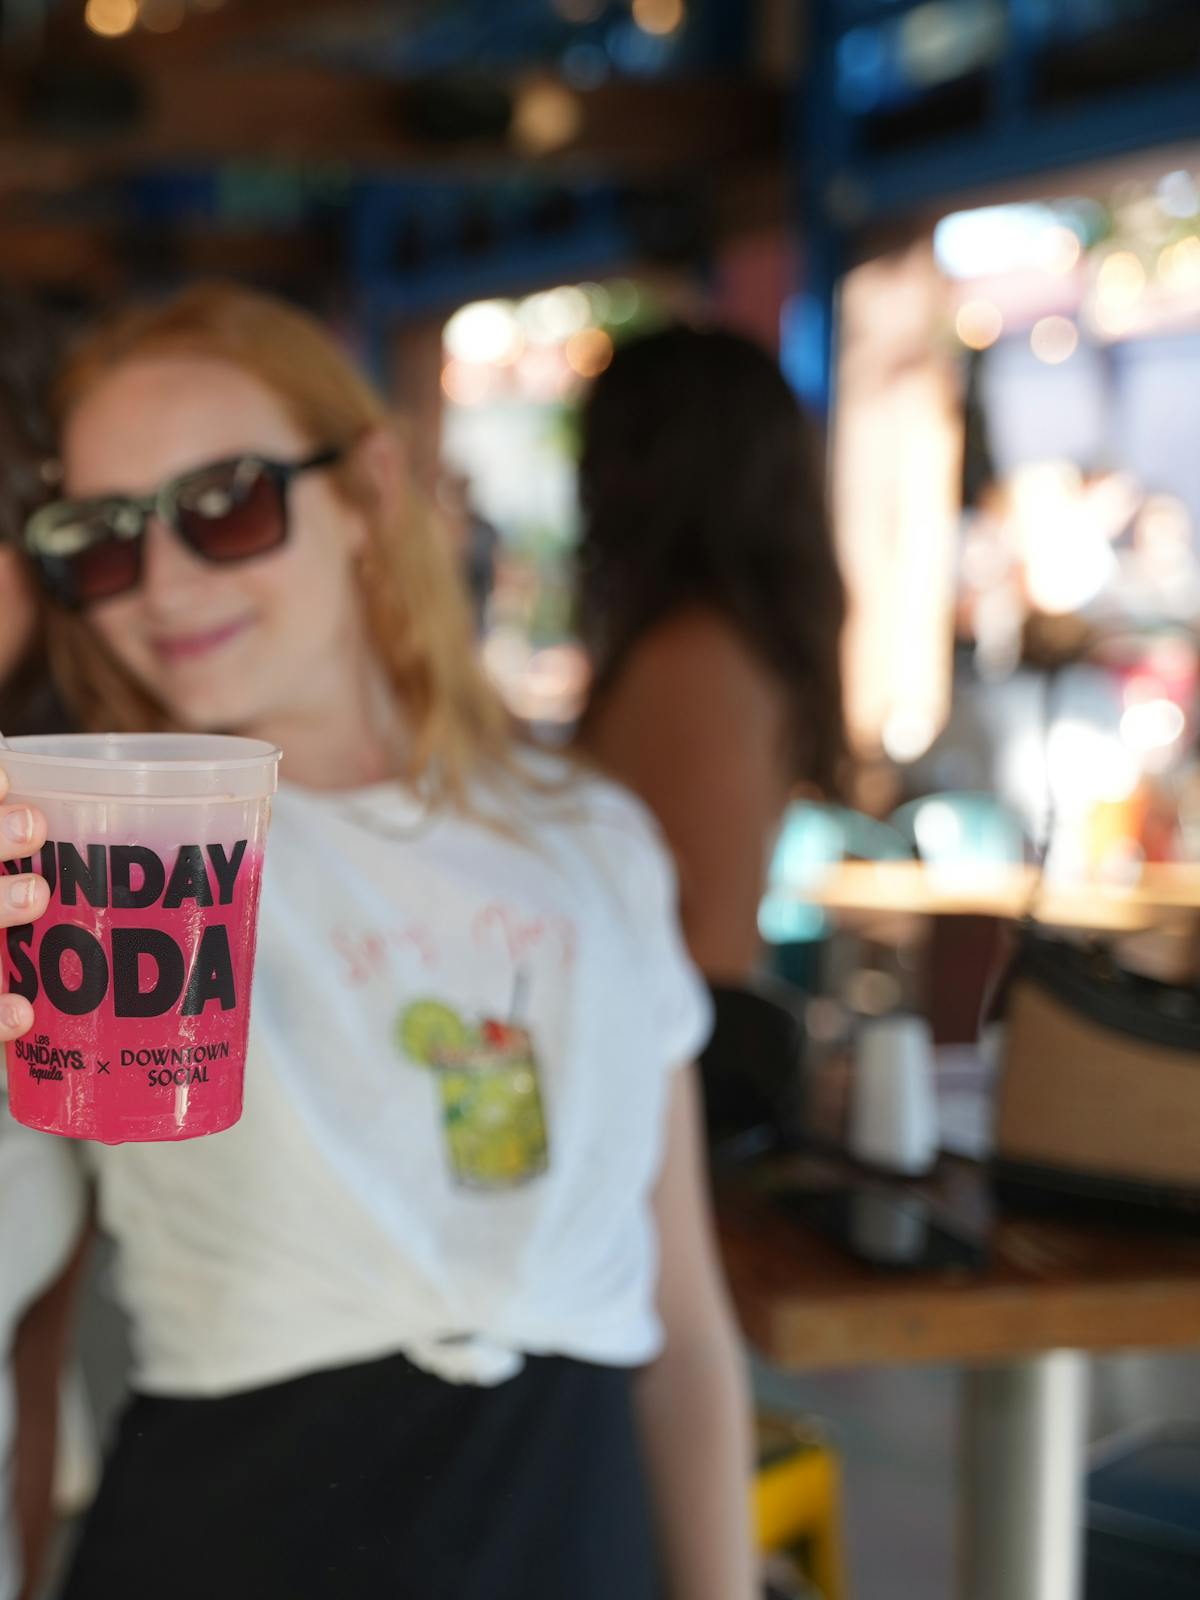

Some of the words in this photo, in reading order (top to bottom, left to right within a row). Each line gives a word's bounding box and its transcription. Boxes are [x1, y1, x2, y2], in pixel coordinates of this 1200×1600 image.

[2, 840, 247, 909] UNDAY
[6, 923, 236, 1018] SODA
[120, 1041, 230, 1066] DOWNTOWN
[28, 1063, 64, 1085] Tequila
[147, 1066, 209, 1087] SOCIAL
